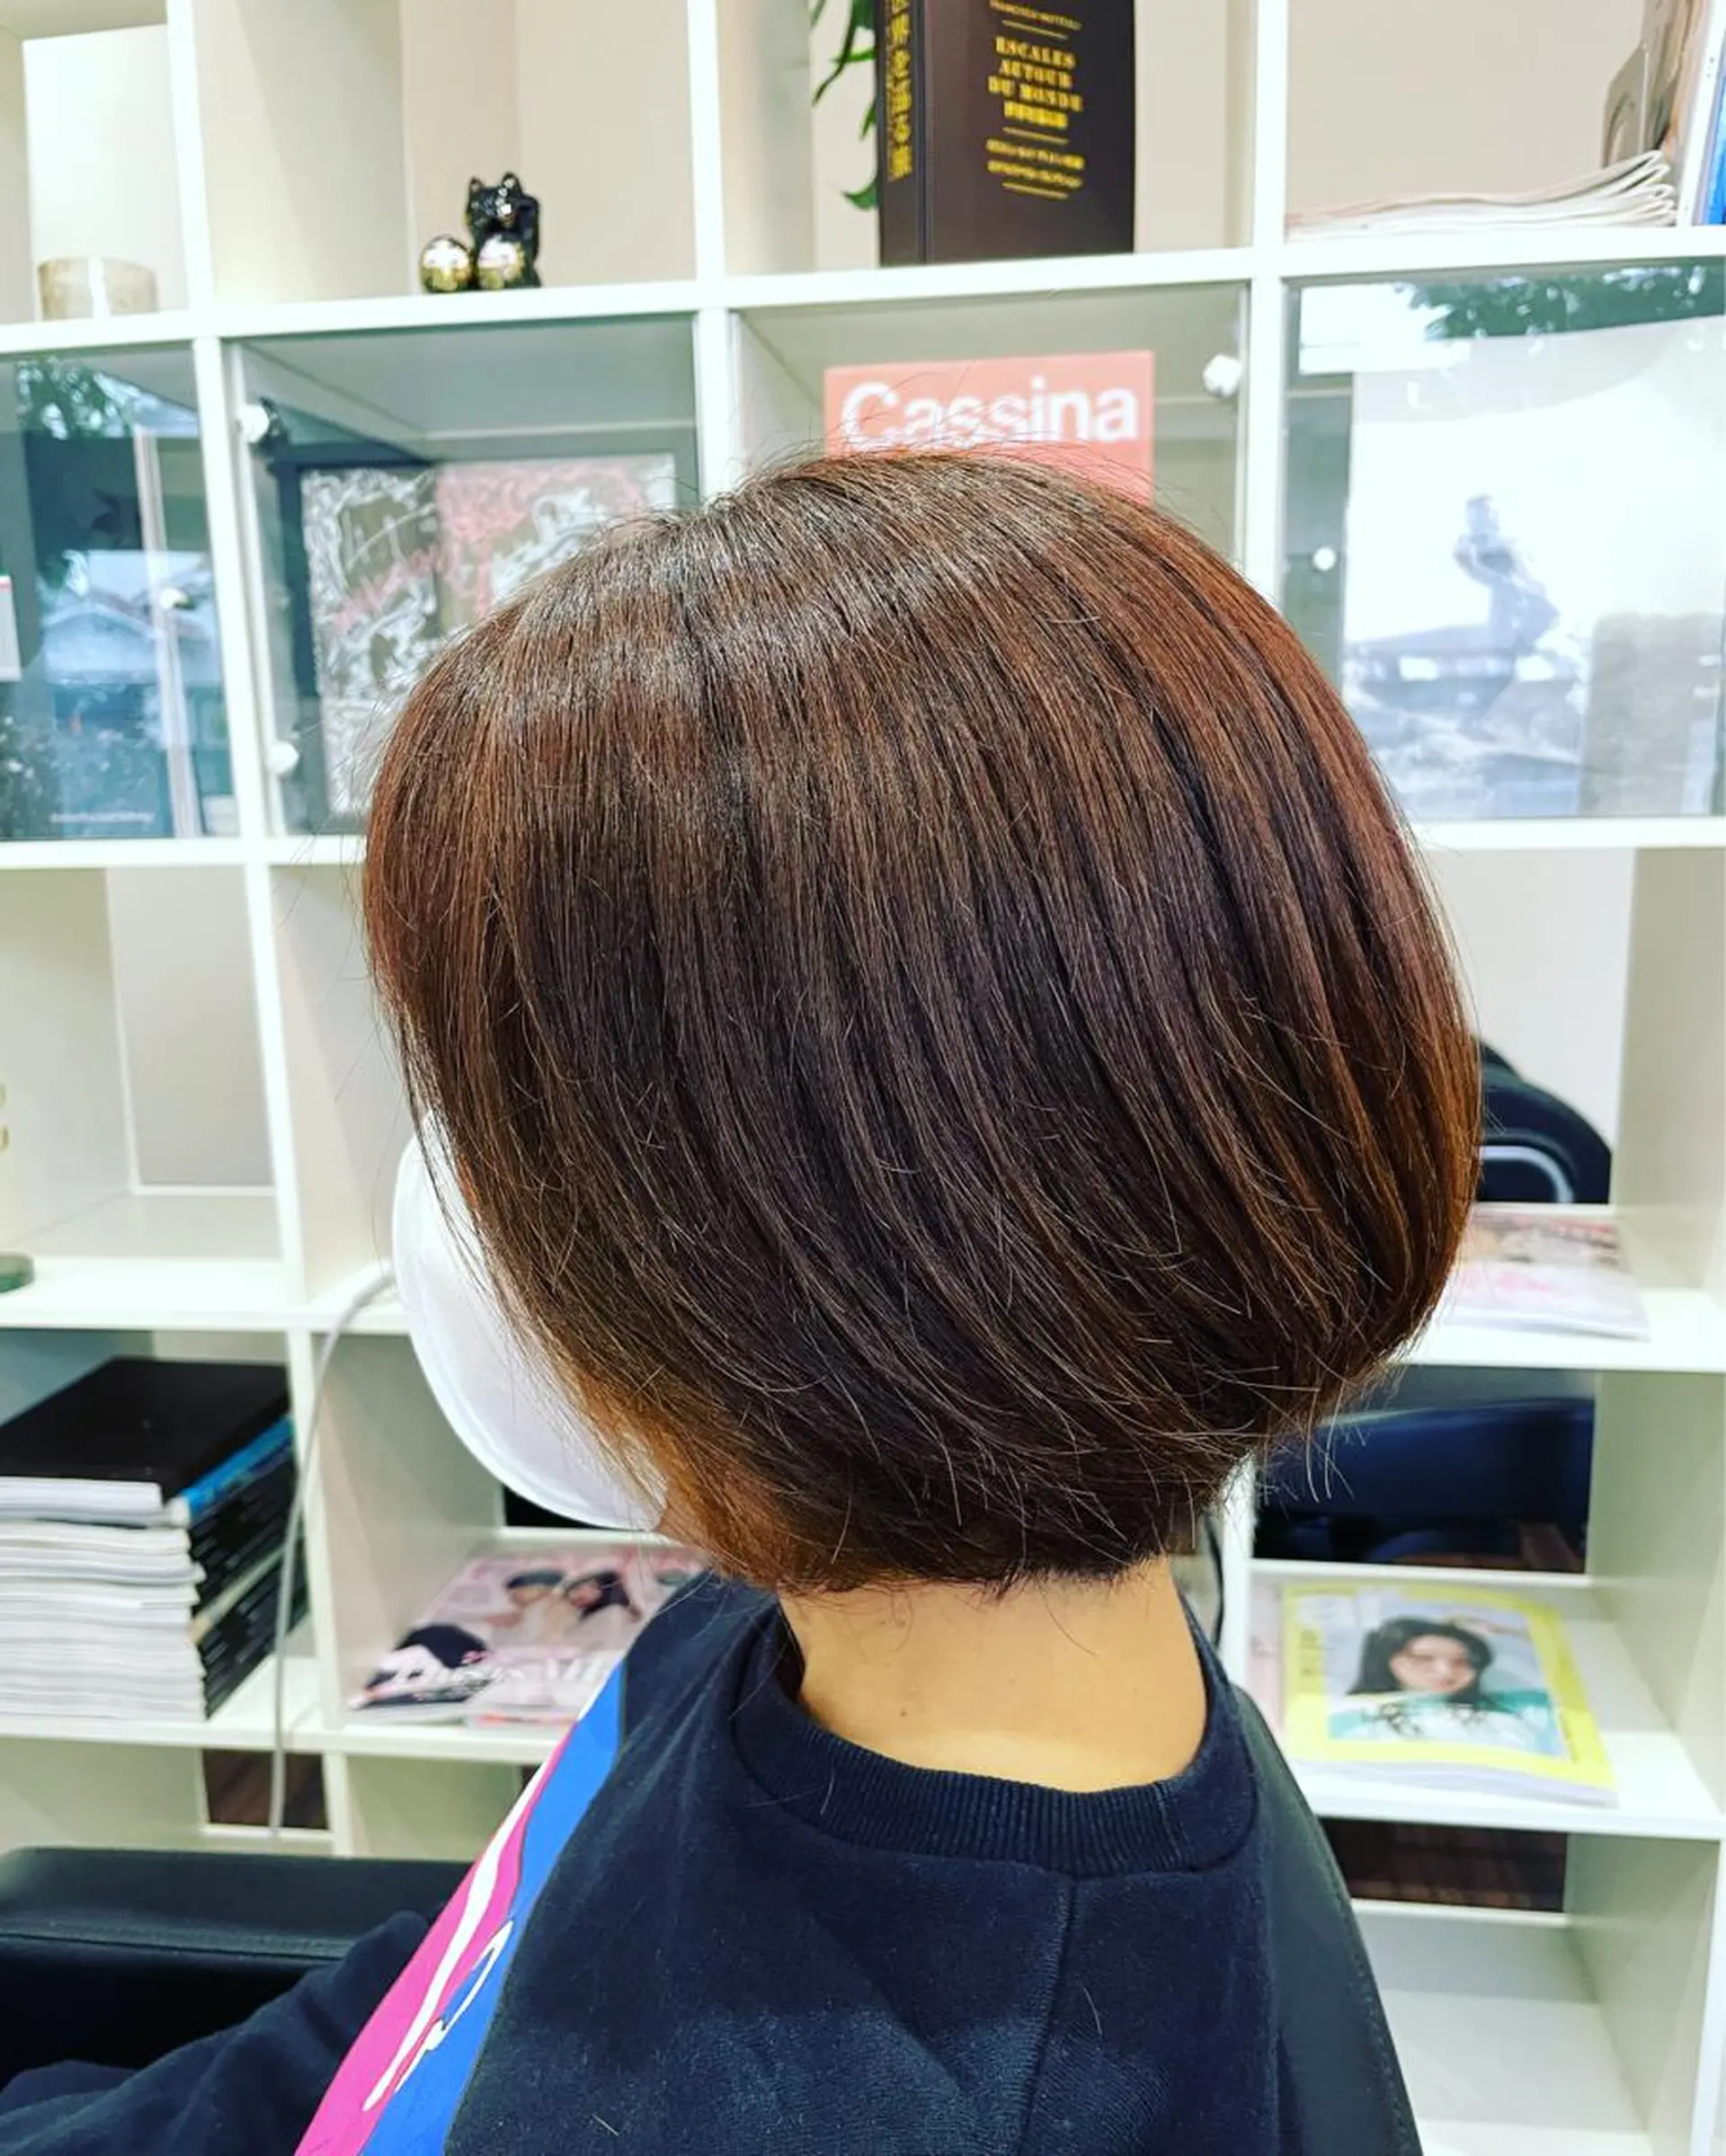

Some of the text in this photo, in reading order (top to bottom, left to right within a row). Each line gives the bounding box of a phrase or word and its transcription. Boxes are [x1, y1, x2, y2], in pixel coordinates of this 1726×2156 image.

[996, 36, 1076, 69] ESCALES
[999, 59, 1073, 89] AUTOUR
[841, 375, 1139, 450] Cassina
